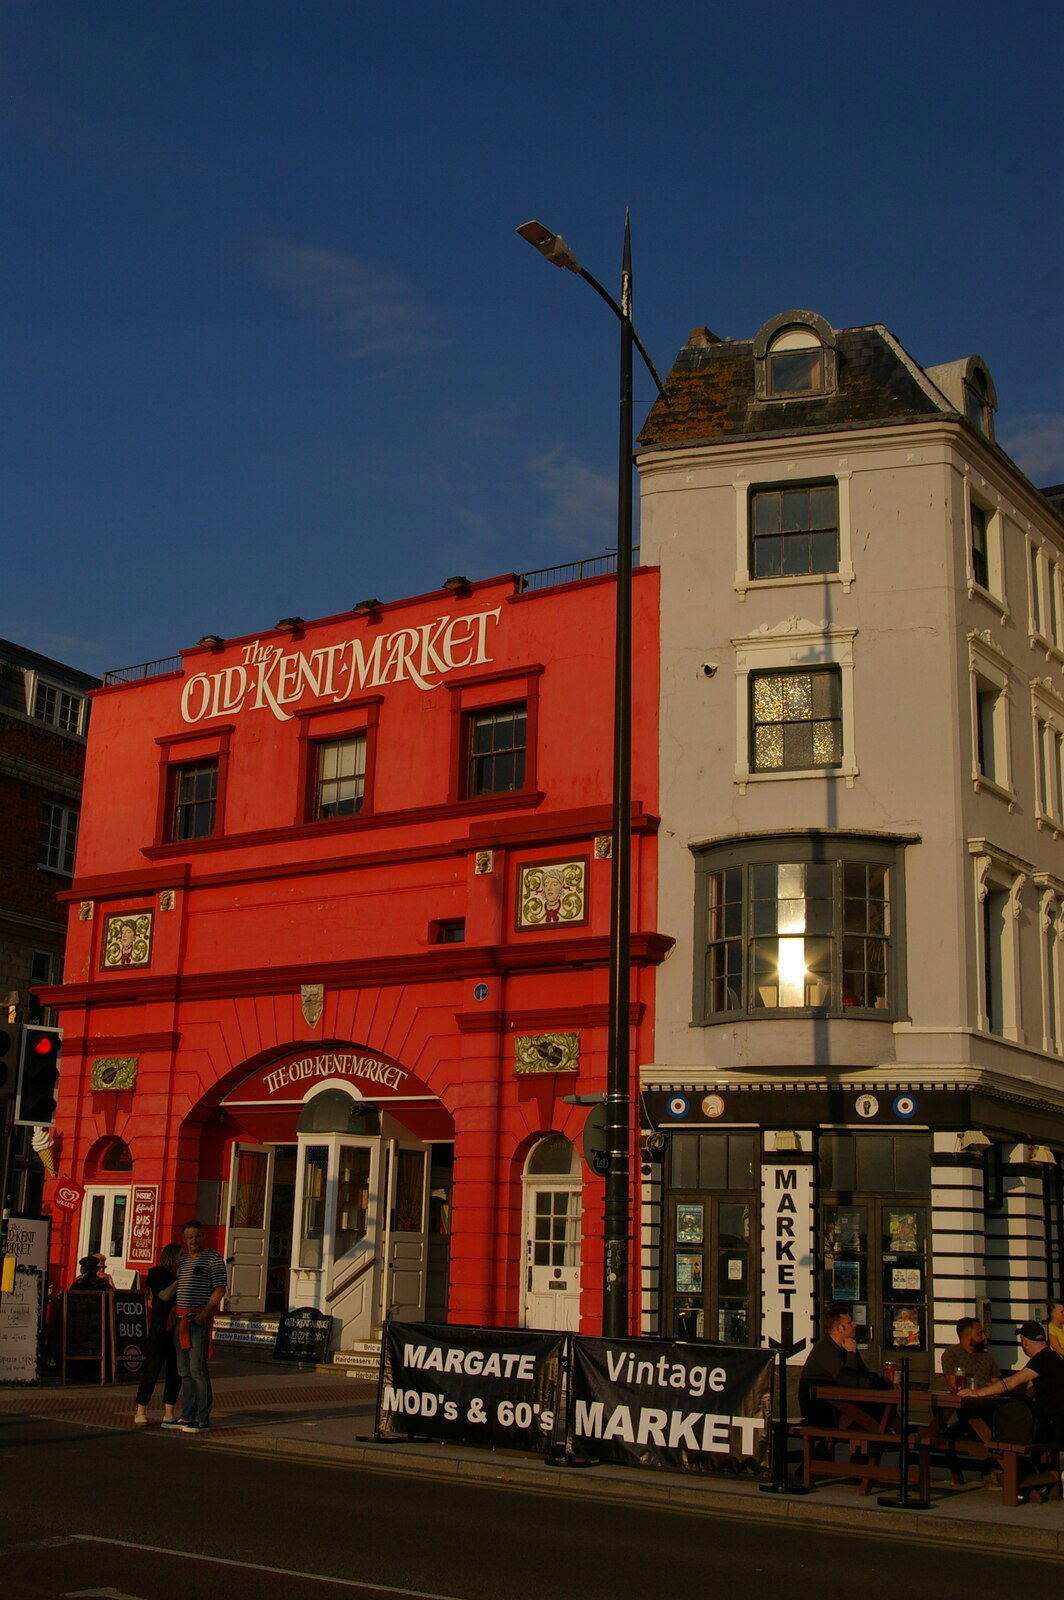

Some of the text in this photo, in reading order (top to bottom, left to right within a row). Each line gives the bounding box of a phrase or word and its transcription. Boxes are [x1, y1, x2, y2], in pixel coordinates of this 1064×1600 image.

[180, 606, 502, 724] OLD KENT MARKET
[241, 640, 274, 667] The
[263, 1054, 409, 1094] THE OLD KENT MARKET
[774, 1168, 797, 1309] MARKET
[574, 1271, 579, 1279] 6
[116, 1302, 143, 1315] FOOD
[119, 1323, 142, 1337] BUS
[335, 1356, 371, 1365] Hairdressers
[403, 1343, 537, 1380] MARGATE
[606, 1350, 728, 1397] Vintage
[382, 1386, 554, 1432] MOD's & 60's
[575, 1399, 765, 1456] MARKET
